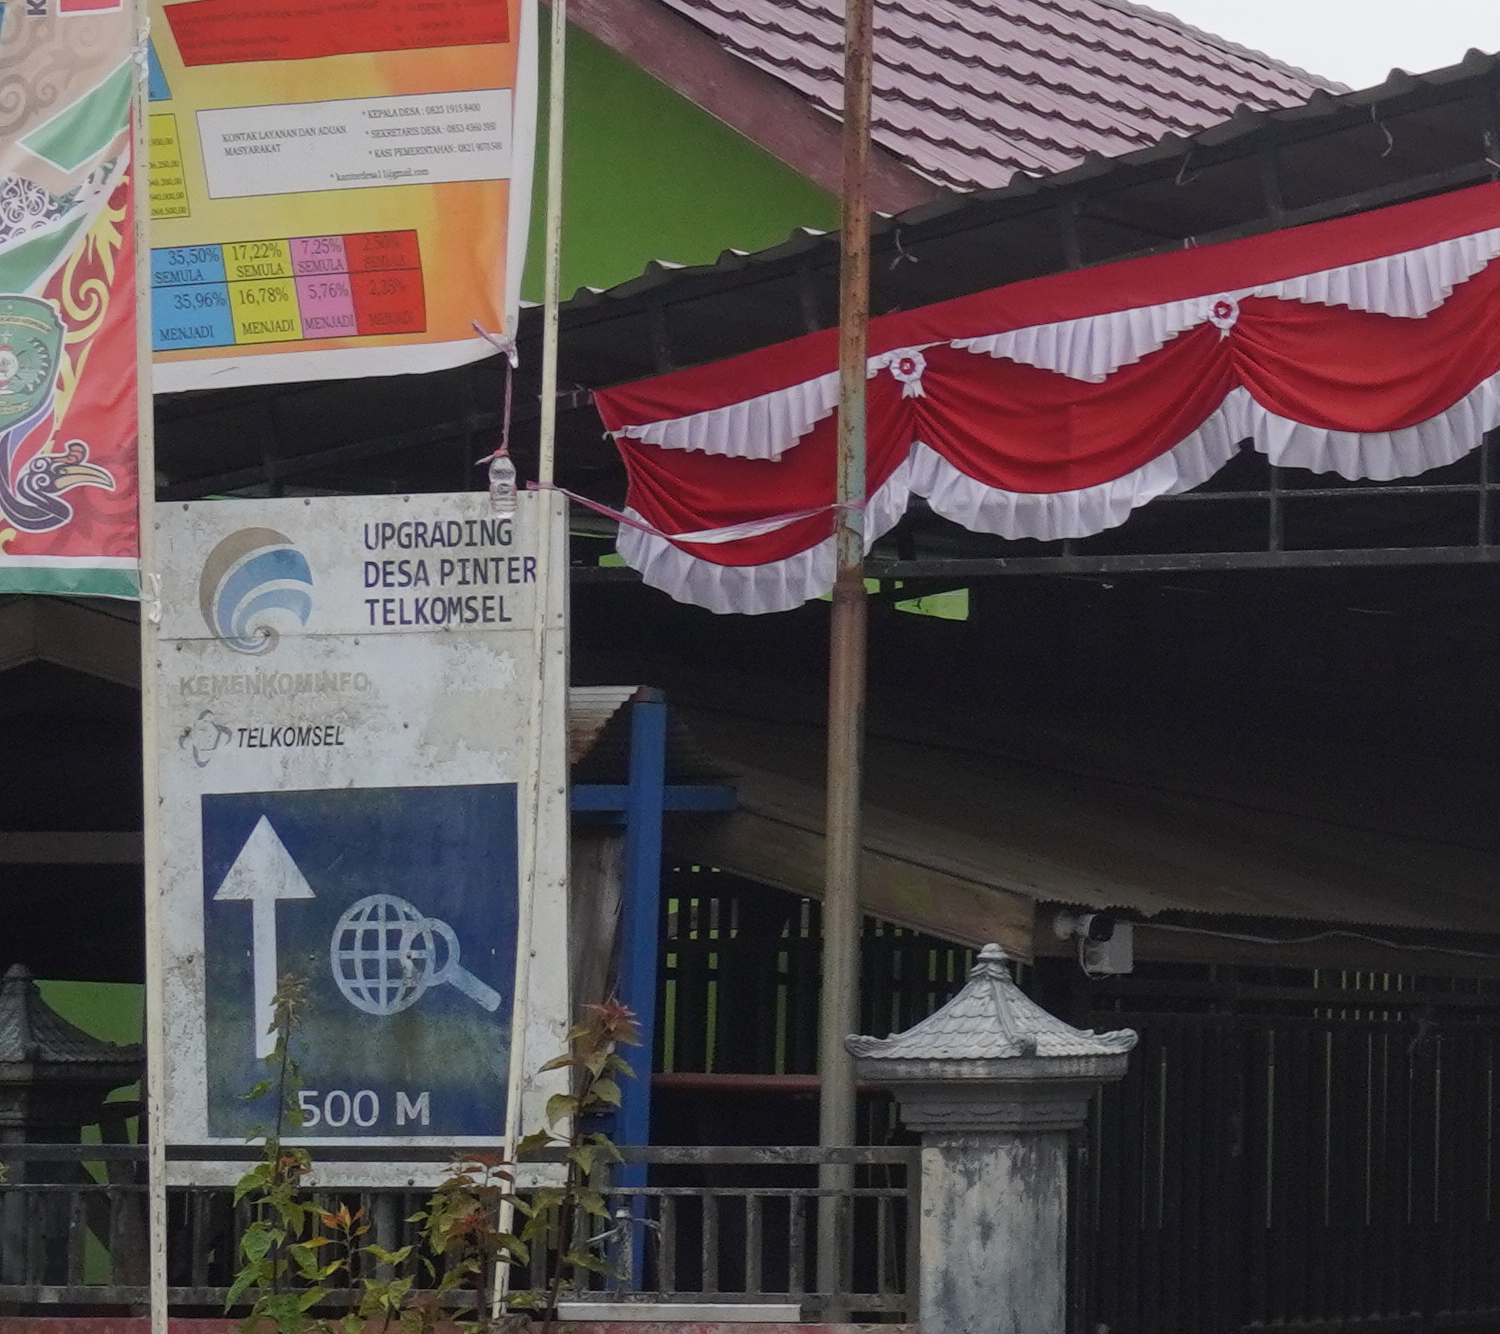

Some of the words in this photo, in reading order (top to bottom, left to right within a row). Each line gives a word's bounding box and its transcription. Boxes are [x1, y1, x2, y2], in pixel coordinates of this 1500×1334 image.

[258, 128, 300, 141] LAYANAN
[300, 126, 316, 139] DAN
[317, 124, 348, 138] ADUAN
[223, 142, 282, 157] MASYARAKAT
[168, 248, 220, 265] 35,50%
[231, 244, 283, 262] 17,22%
[156, 270, 205, 284] SEMULA
[236, 263, 285, 278] SEMULA
[298, 259, 344, 274] SEMULA
[173, 293, 226, 310] 35,96%
[239, 287, 289, 305] 16,78%
[308, 282, 350, 301] 5,76%
[160, 325, 215, 342] MENJADI
[242, 320, 295, 335] MENJADI
[305, 314, 355, 331] MENJADI
[363, 518, 514, 550] UPGRADING
[363, 560, 432, 589] DESA
[439, 554, 539, 586] PINTER
[365, 594, 514, 627] TELKOMSEL
[179, 672, 372, 698] KEMENKOMINFO
[236, 723, 346, 751] TELKOMSEL
[298, 1090, 381, 1127] 500
[396, 1089, 431, 1126] M
